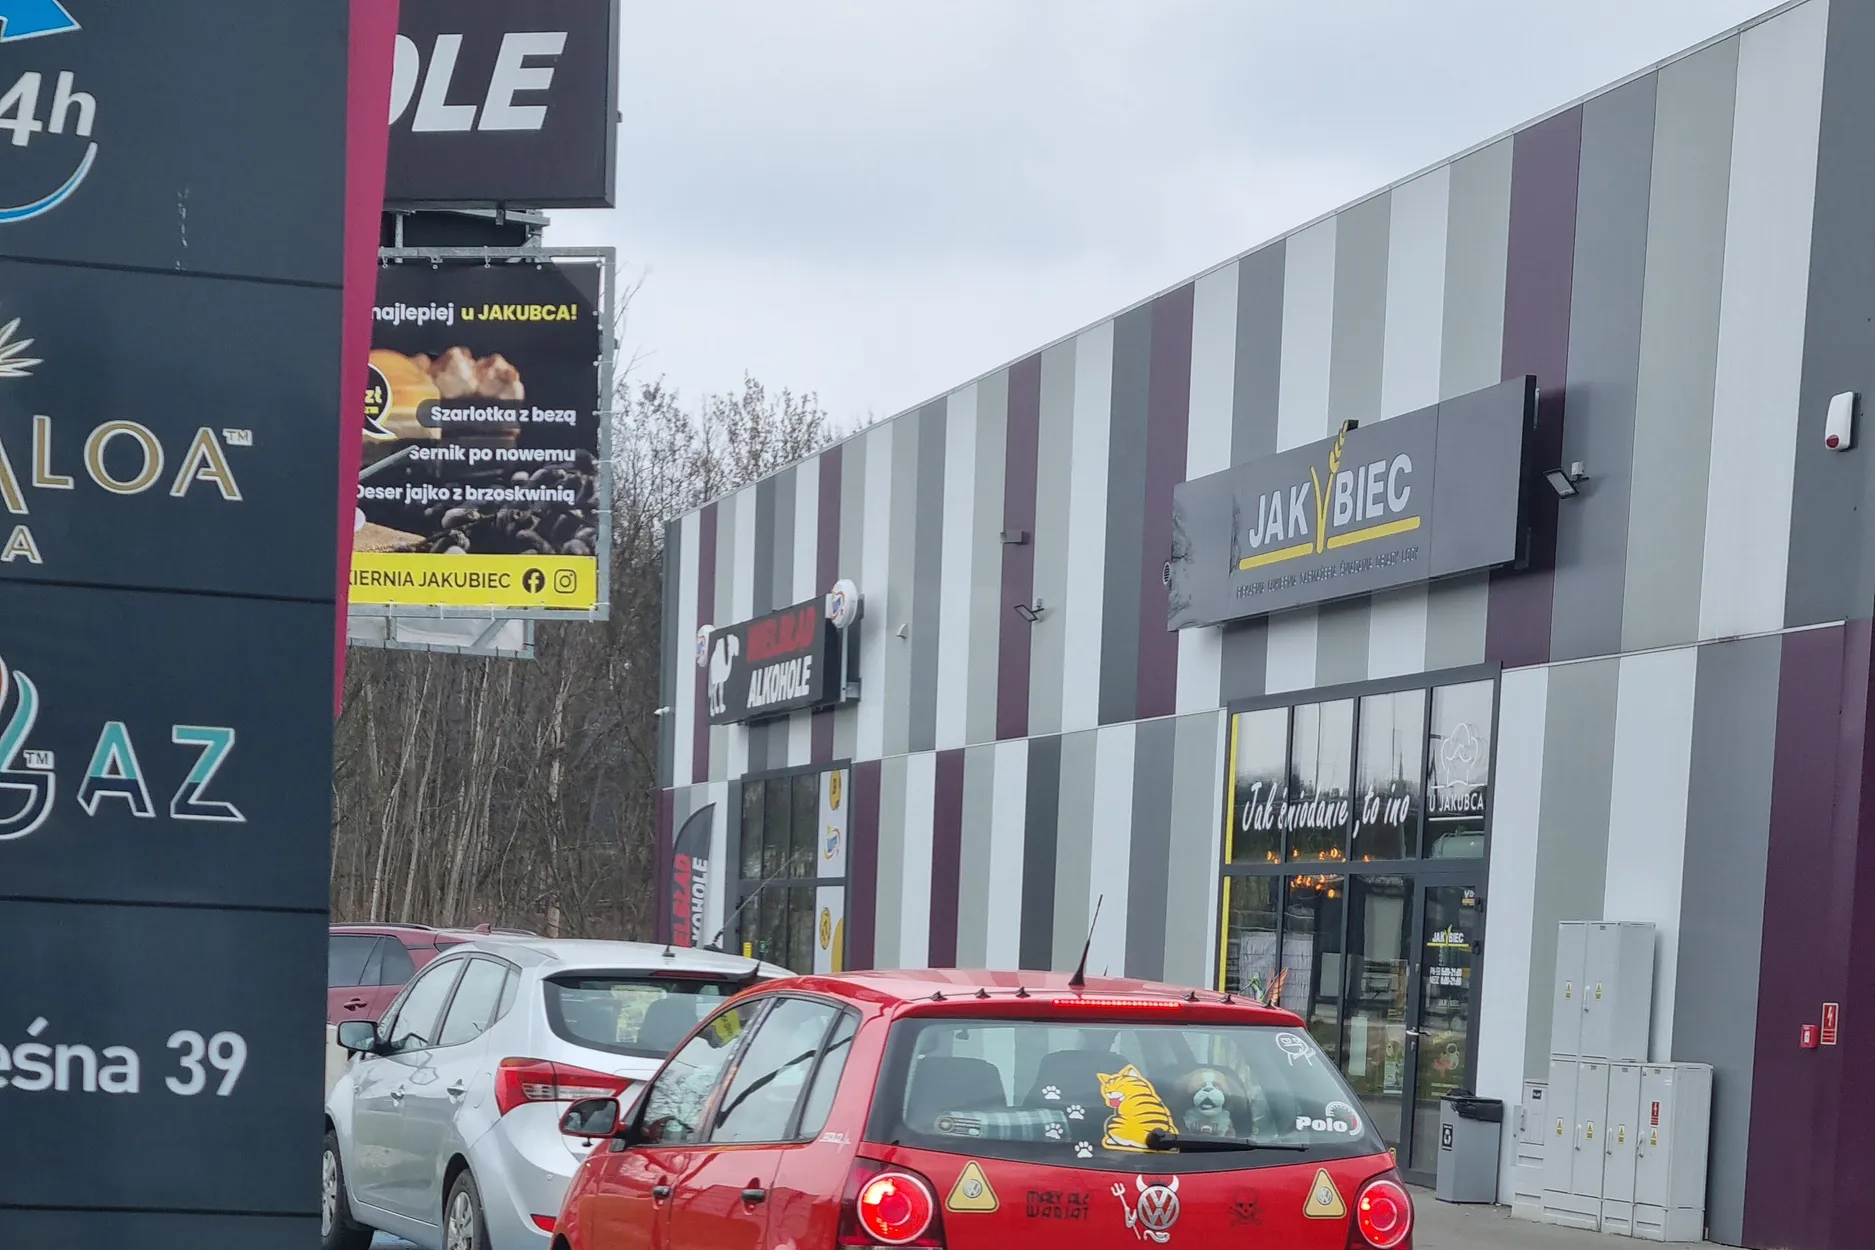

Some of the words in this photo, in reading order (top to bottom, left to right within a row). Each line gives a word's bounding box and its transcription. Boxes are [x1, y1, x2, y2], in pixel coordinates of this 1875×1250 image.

[372, 302, 454, 326] najlepiej
[461, 307, 474, 321] u
[478, 304, 577, 322] JAKUBCA!
[430, 406, 516, 424] Szarlotka
[519, 410, 530, 422] z
[532, 406, 577, 426] bezą
[409, 444, 466, 463] Sernik
[469, 448, 494, 466] po
[496, 448, 576, 463] nowemu
[405, 483, 450, 505] jajko
[452, 487, 462, 500] z
[465, 484, 575, 505] brzoskwinią
[418, 571, 511, 589] JAKUBIEC
[746, 655, 813, 708] ALKOHOLE
[1242, 781, 1277, 832] Jak
[1438, 792, 1485, 812] JAKUBCA
[0, 1016, 140, 1094] śna
[165, 1030, 247, 1096] 39
[1295, 1115, 1348, 1133] Polo
